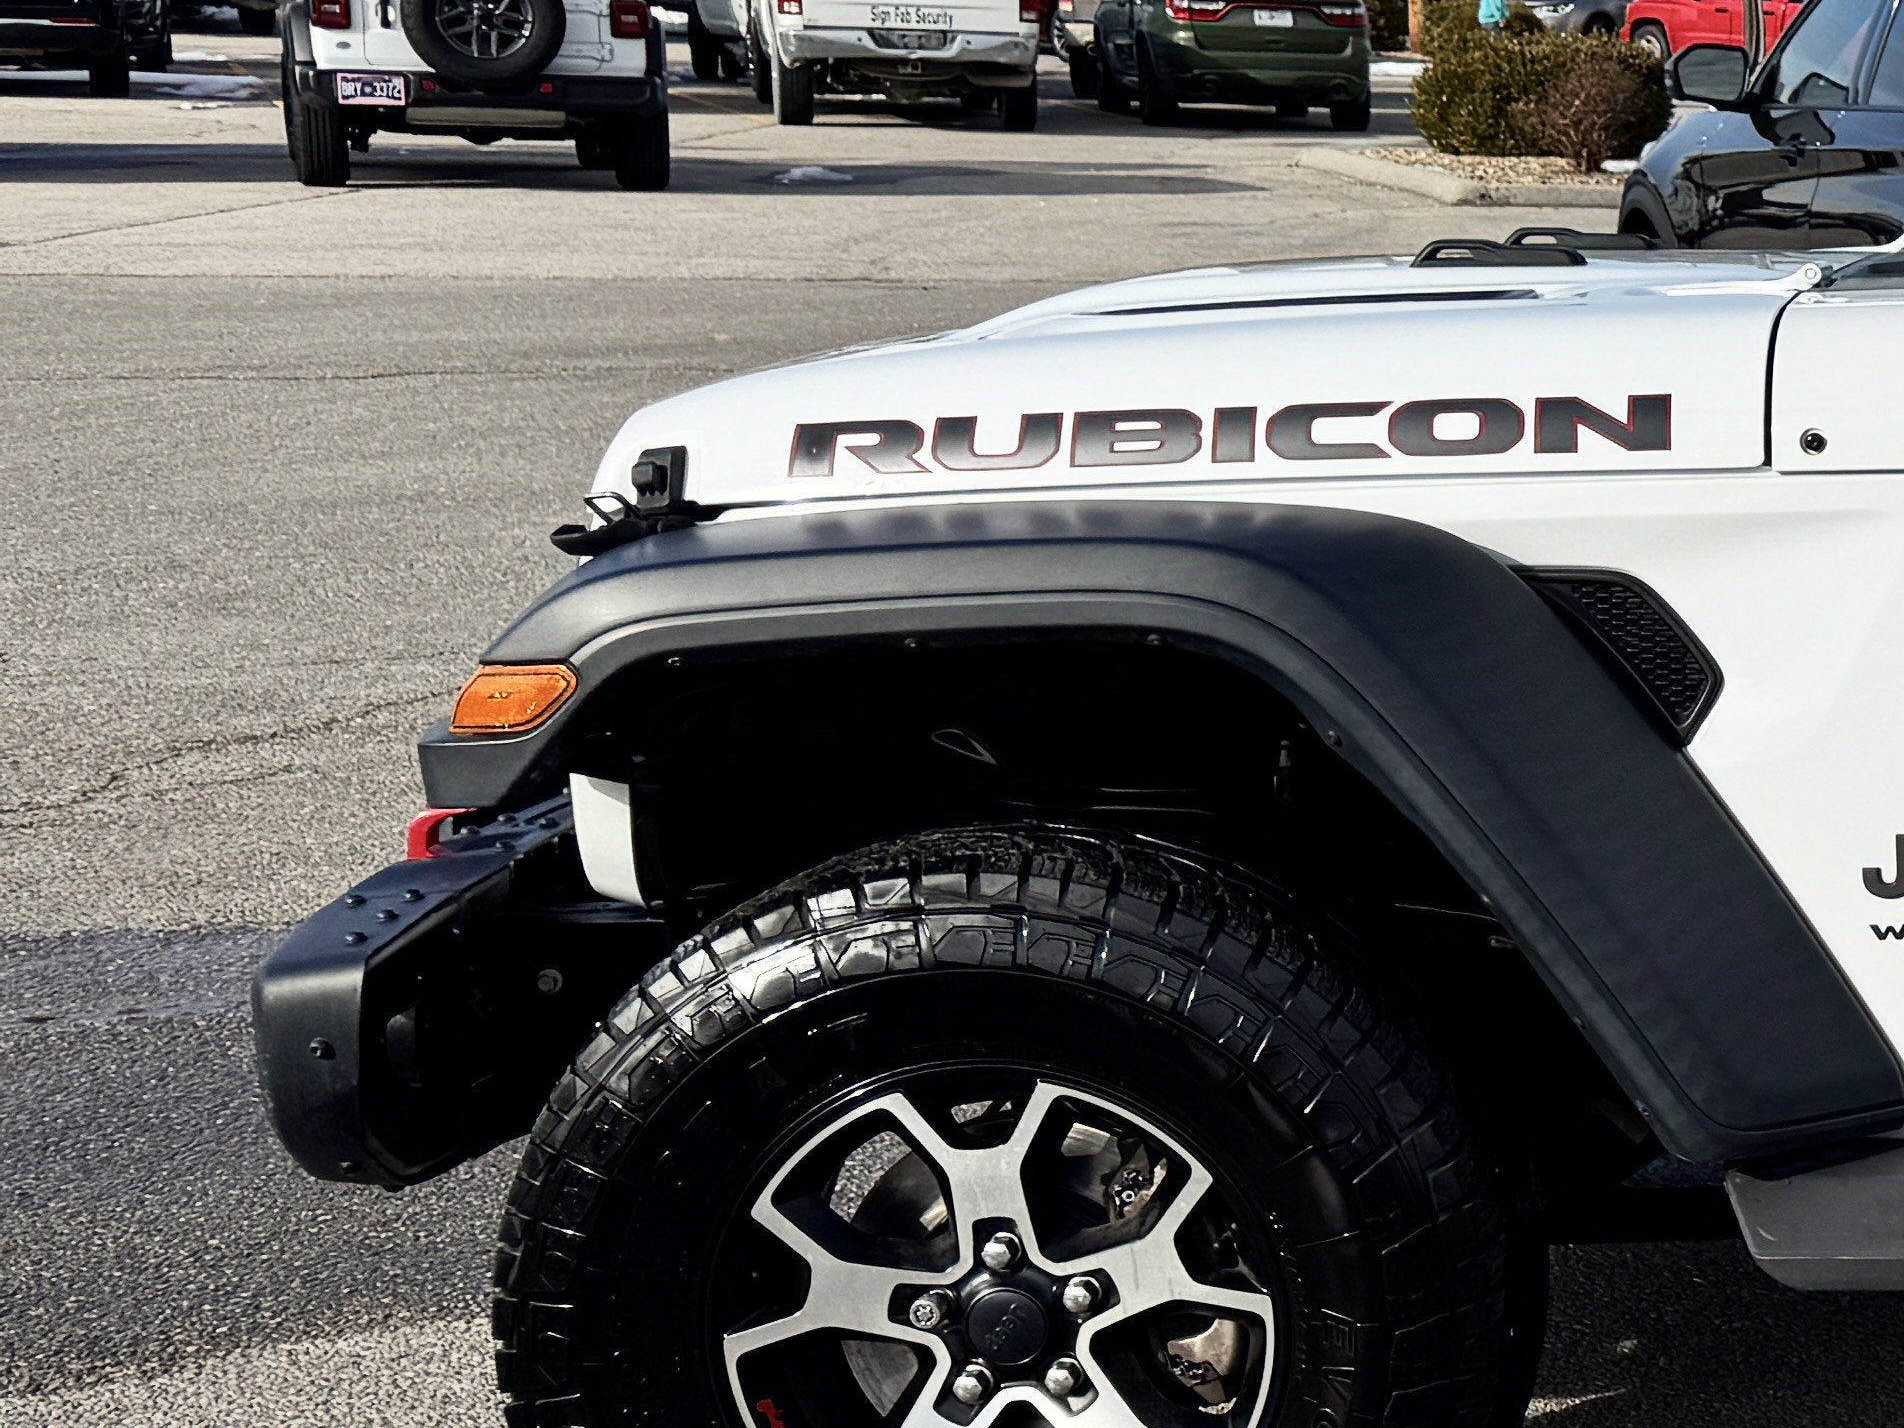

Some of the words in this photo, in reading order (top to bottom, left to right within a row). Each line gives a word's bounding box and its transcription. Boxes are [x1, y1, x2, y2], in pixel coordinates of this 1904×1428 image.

[871, 5, 891, 26] Sign
[915, 6, 953, 28] Security
[786, 393, 1673, 478] RUBICON
